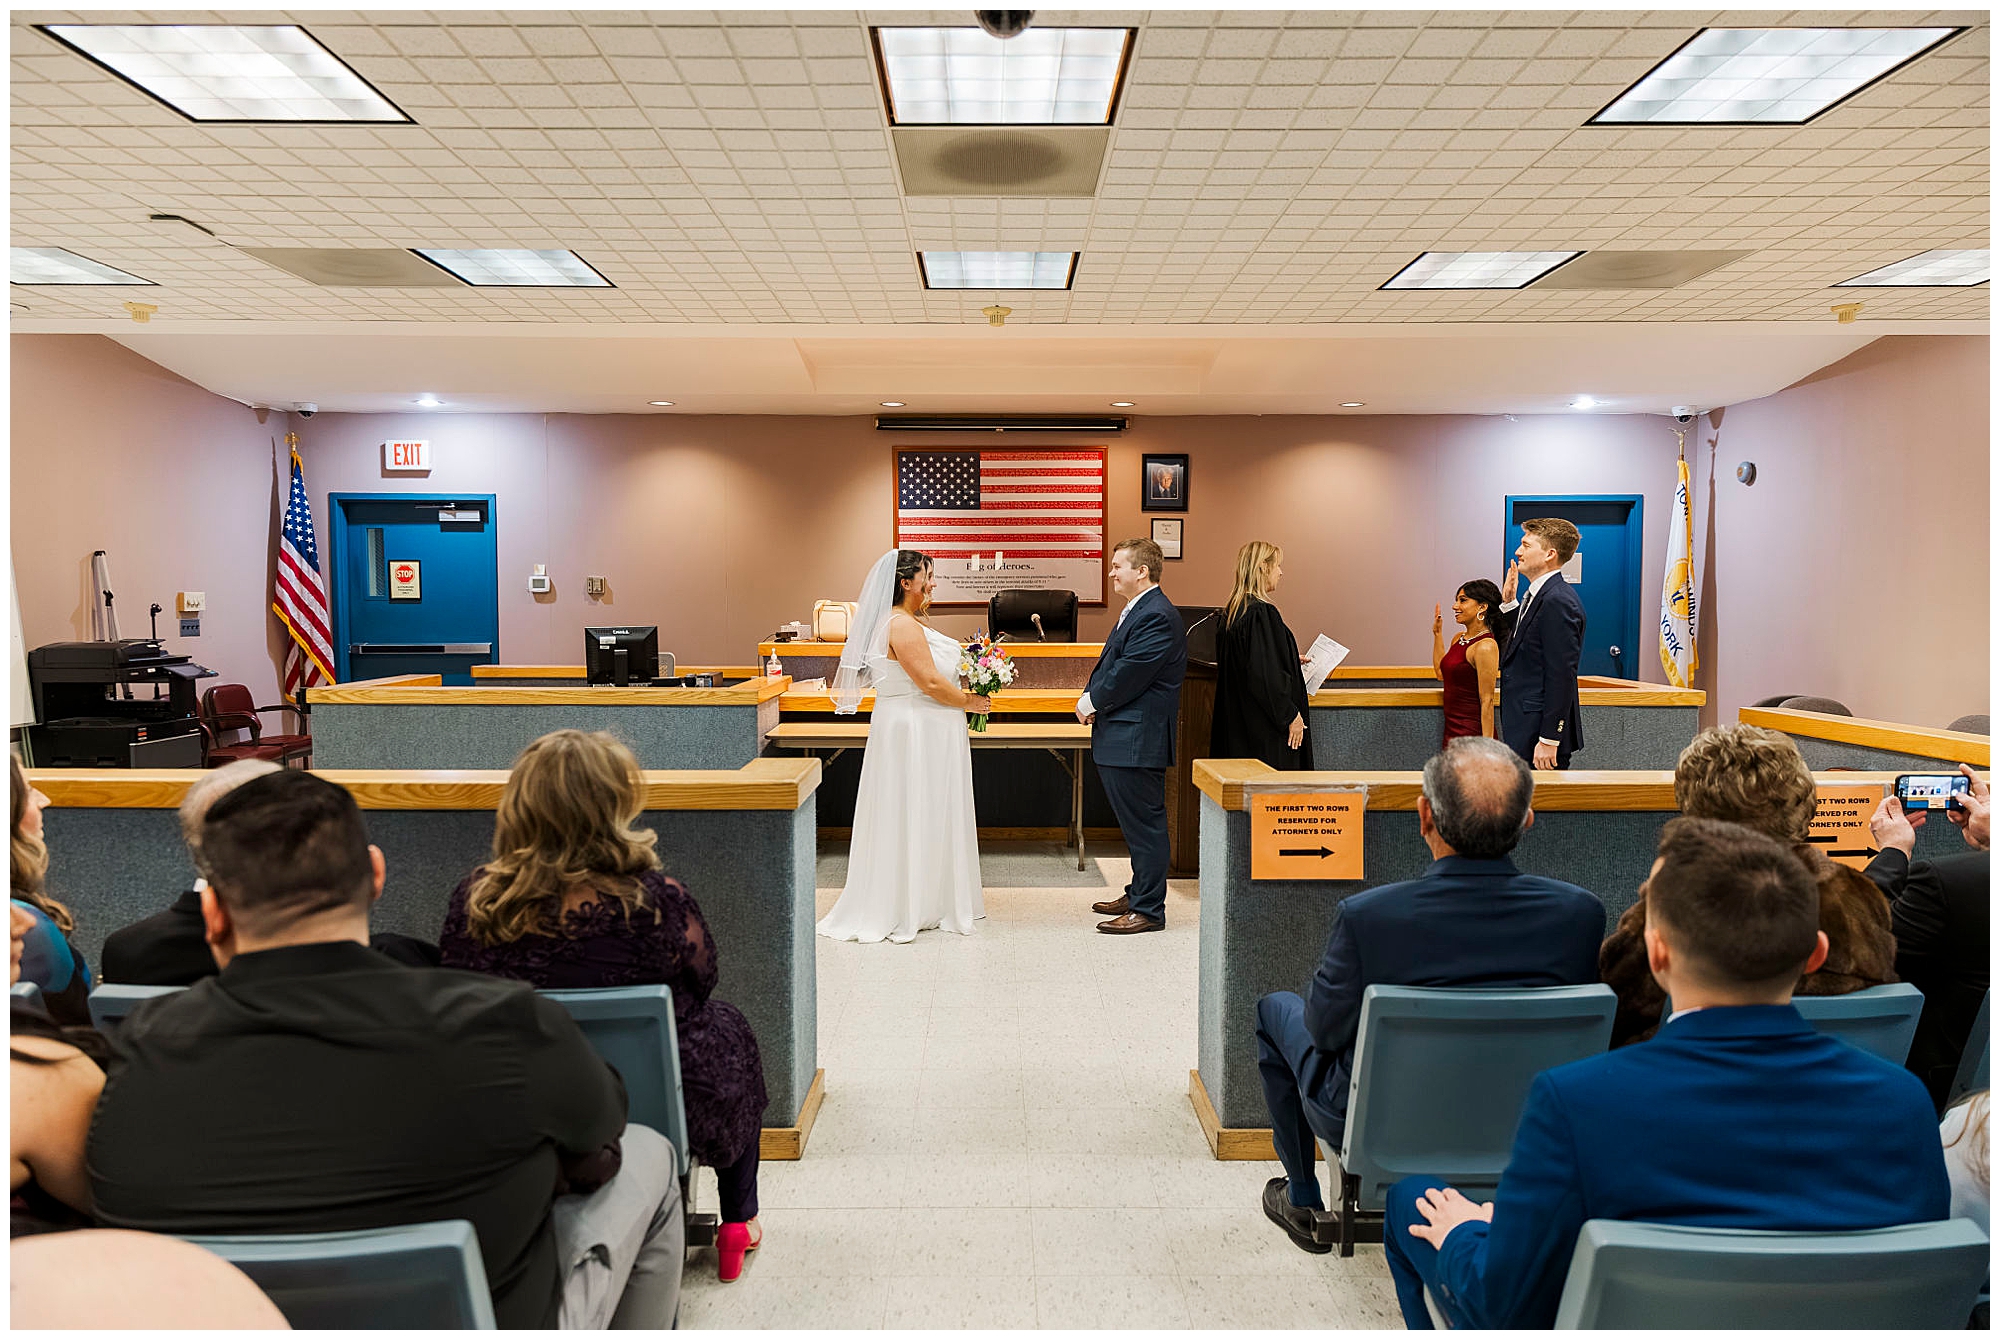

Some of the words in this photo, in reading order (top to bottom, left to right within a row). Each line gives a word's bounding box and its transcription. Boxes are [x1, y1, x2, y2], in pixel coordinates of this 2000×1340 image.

[393, 443, 422, 466] EXIT
[396, 570, 413, 578] STOP
[1660, 613, 1684, 657] YORK
[1843, 820, 1864, 828] ONLY
